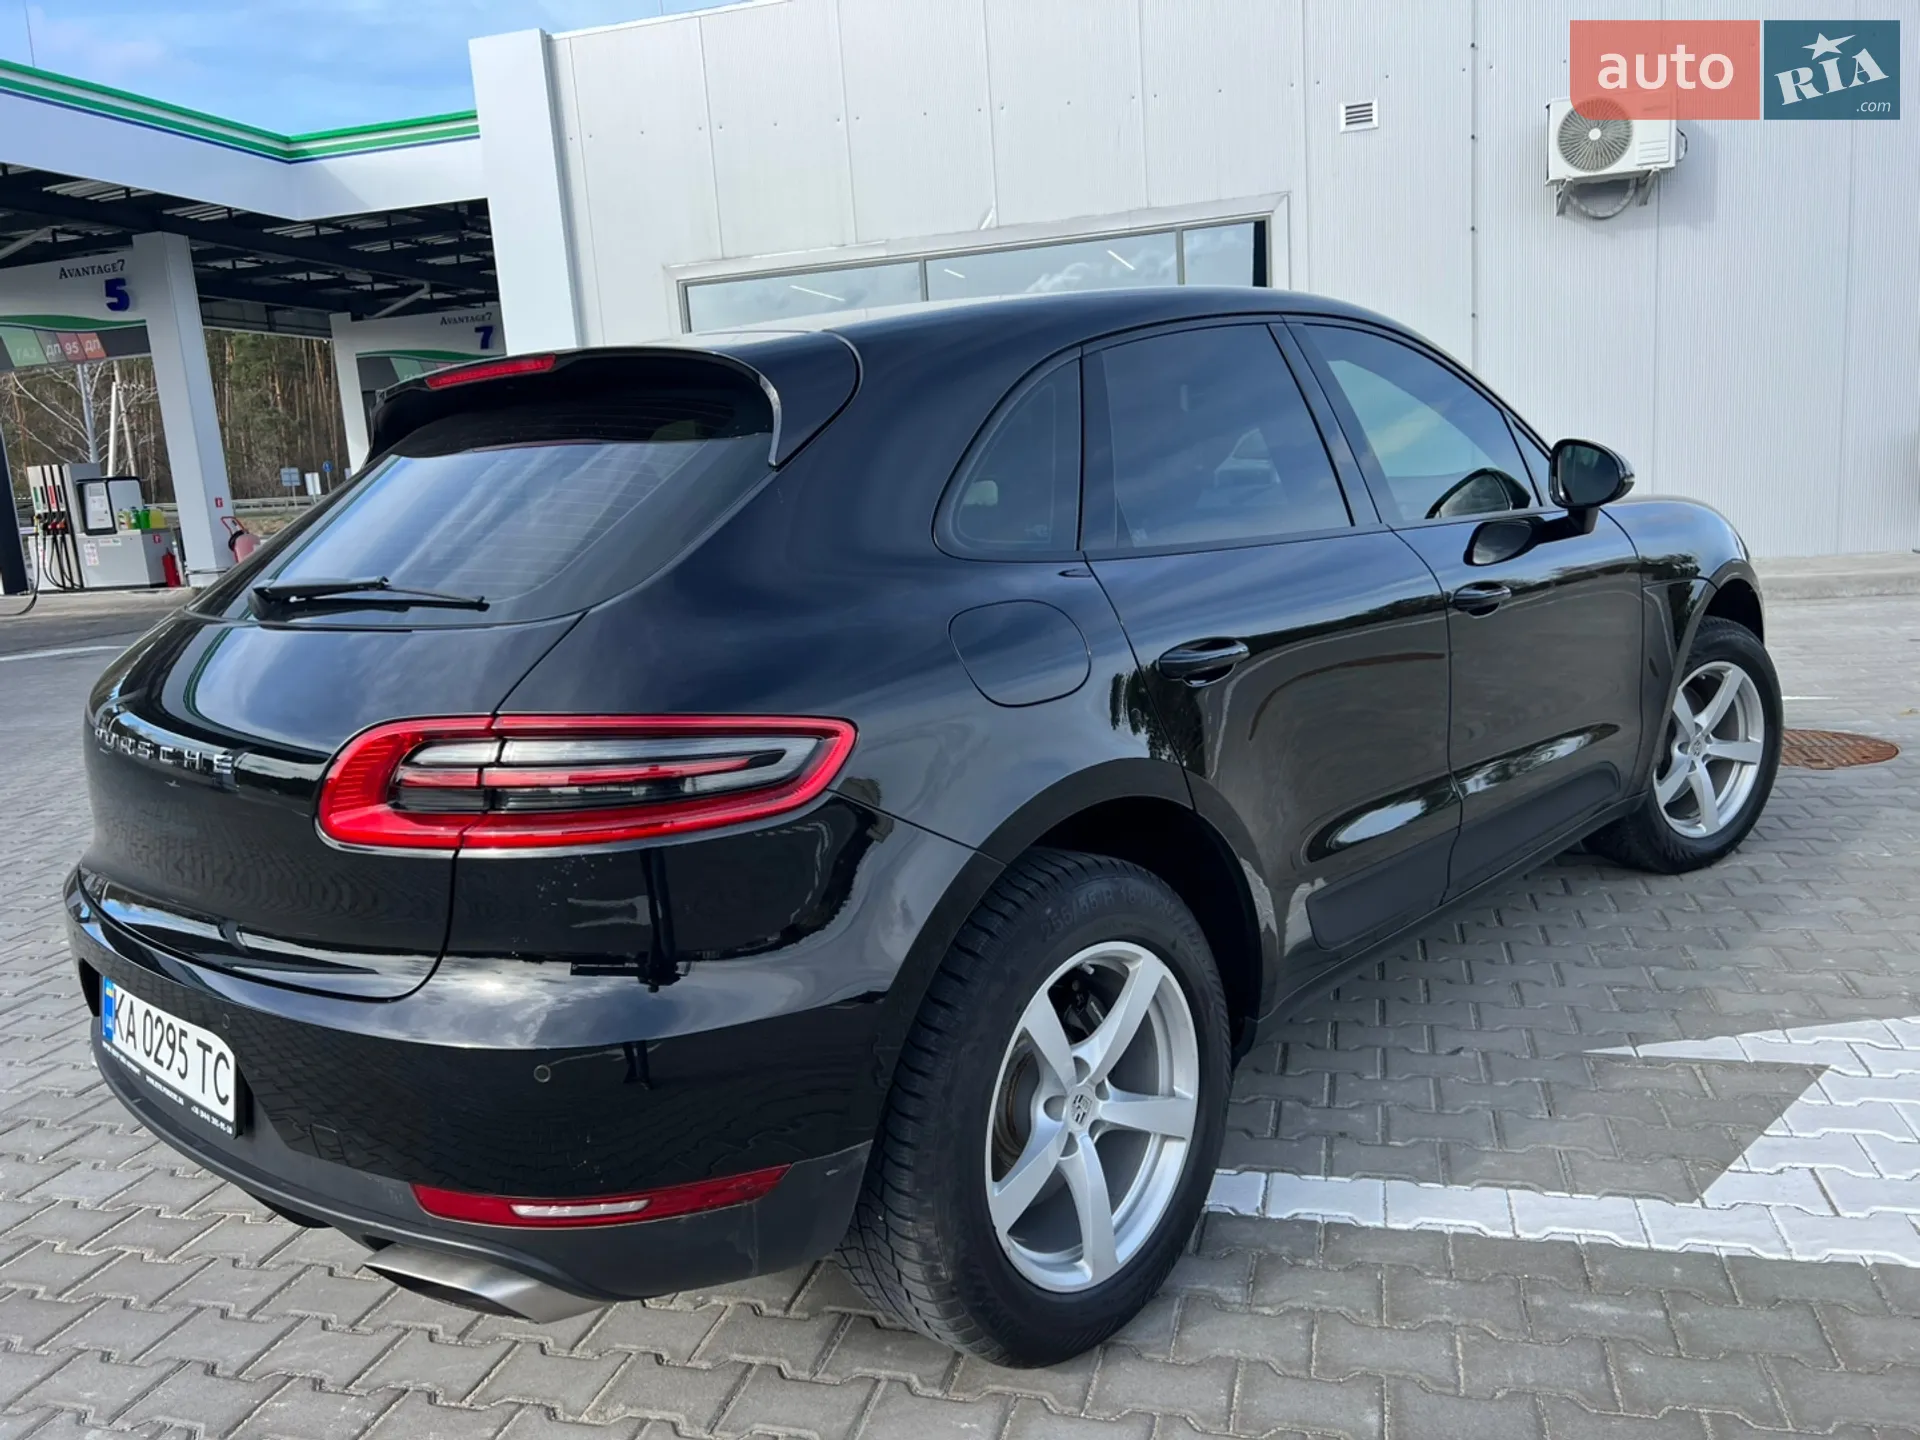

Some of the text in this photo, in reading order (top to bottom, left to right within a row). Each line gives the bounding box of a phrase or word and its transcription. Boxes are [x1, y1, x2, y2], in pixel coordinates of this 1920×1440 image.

[104, 278, 130, 312] 5
[65, 341, 79, 355] 95
[475, 325, 494, 349] 7
[114, 988, 137, 1051] KA
[143, 1008, 189, 1080] 0295
[196, 1038, 231, 1106] TC
